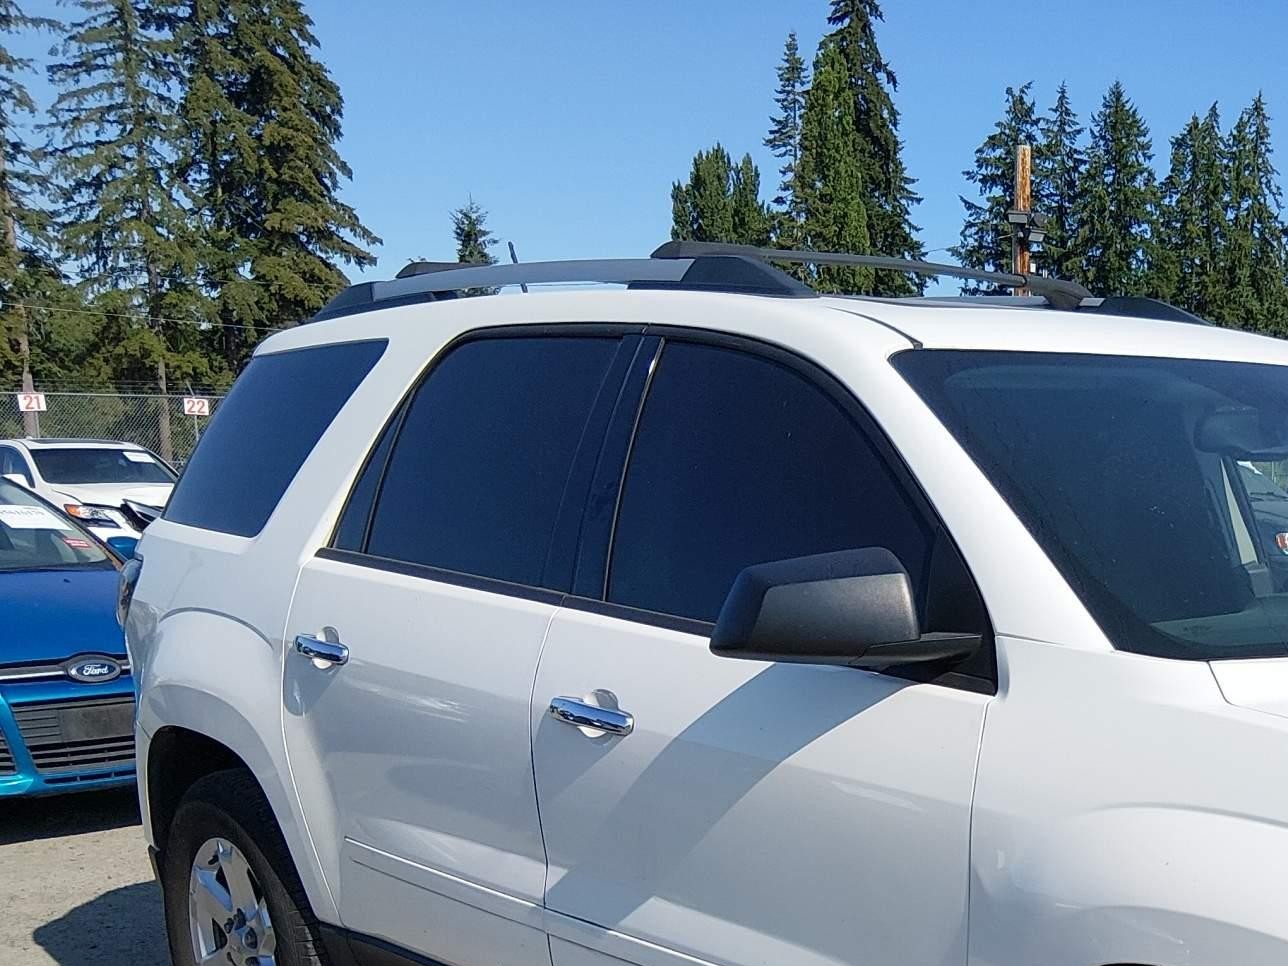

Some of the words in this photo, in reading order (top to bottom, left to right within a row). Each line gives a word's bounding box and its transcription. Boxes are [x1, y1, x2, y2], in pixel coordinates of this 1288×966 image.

[23, 395, 41, 410] 21
[187, 399, 206, 414] 22
[83, 664, 109, 676] Ford
